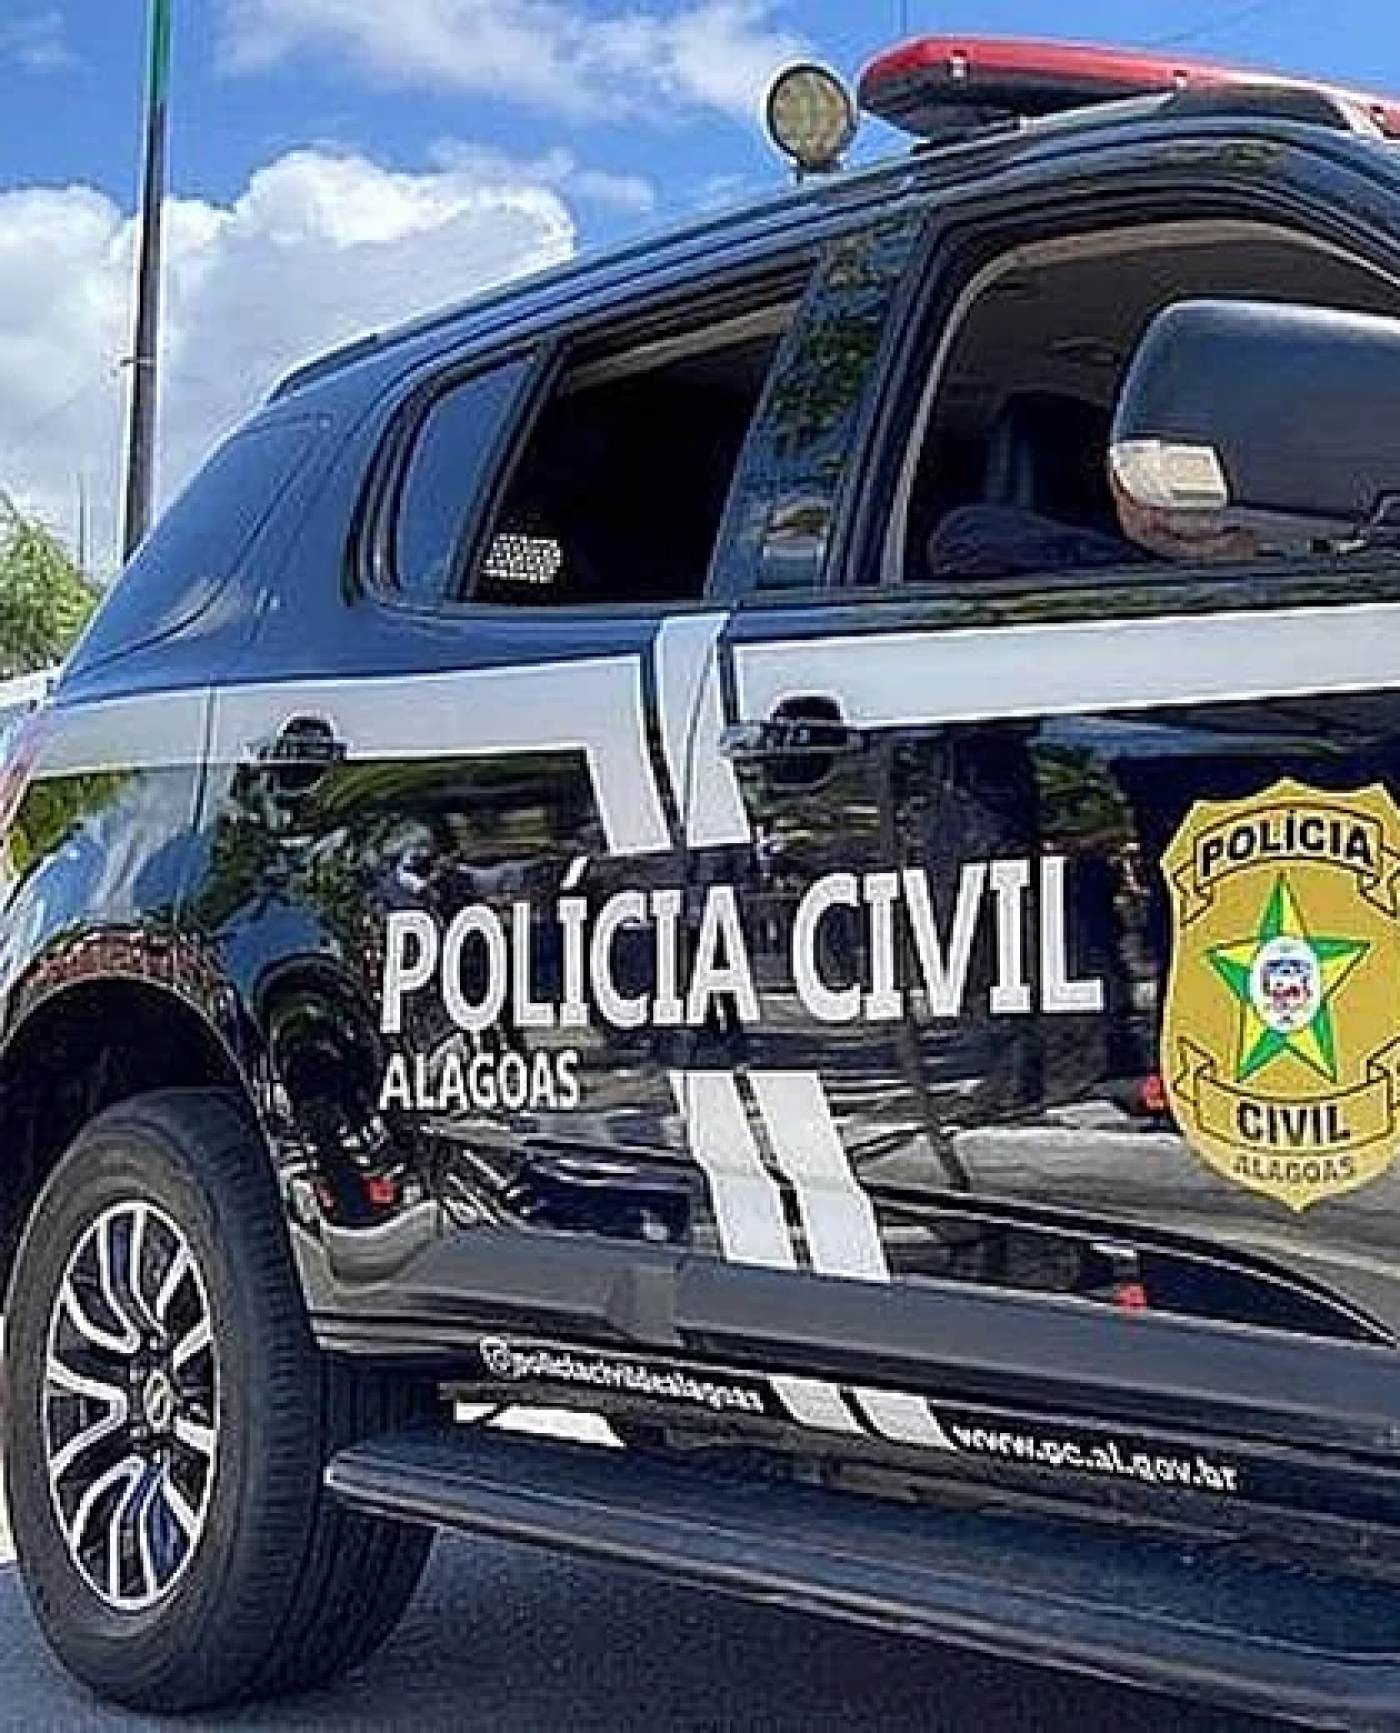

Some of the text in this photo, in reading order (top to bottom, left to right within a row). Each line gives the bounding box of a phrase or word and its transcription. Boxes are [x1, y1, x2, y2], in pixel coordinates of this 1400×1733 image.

[1201, 811, 1374, 876] POLÍCIA
[380, 856, 1104, 1033] POLÍCIA CIVIL
[380, 1050, 580, 1110] ALAGOAS
[1237, 1101, 1351, 1144] CIVIL
[1235, 1154, 1355, 1184] ALAGOAS
[952, 1426, 1237, 1490] www.pc.al.gov.br
